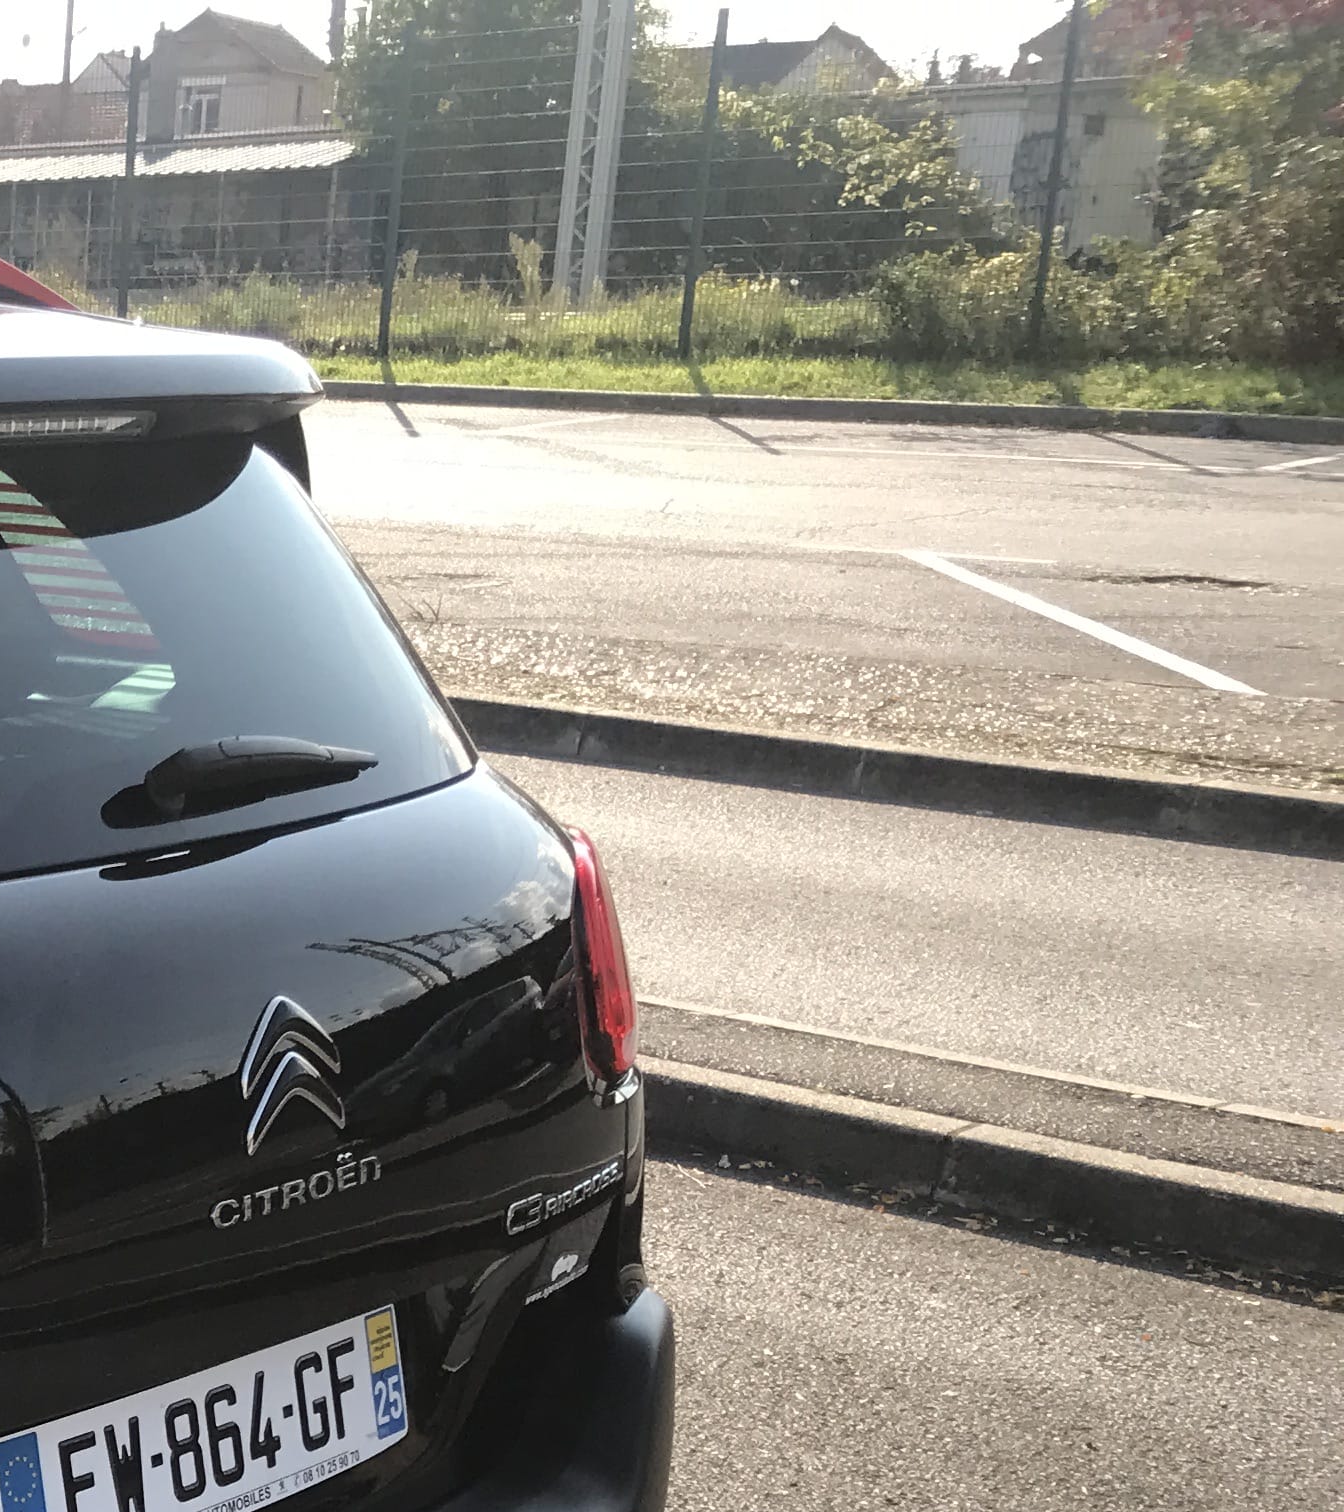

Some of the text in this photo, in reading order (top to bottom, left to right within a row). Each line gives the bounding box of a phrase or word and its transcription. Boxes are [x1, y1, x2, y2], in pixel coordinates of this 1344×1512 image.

[374, 1374, 403, 1426] 25
[316, 1465, 325, 1479] 10
[328, 1459, 337, 1474] 25
[339, 1455, 349, 1469] 90
[350, 1450, 360, 1463] 70
